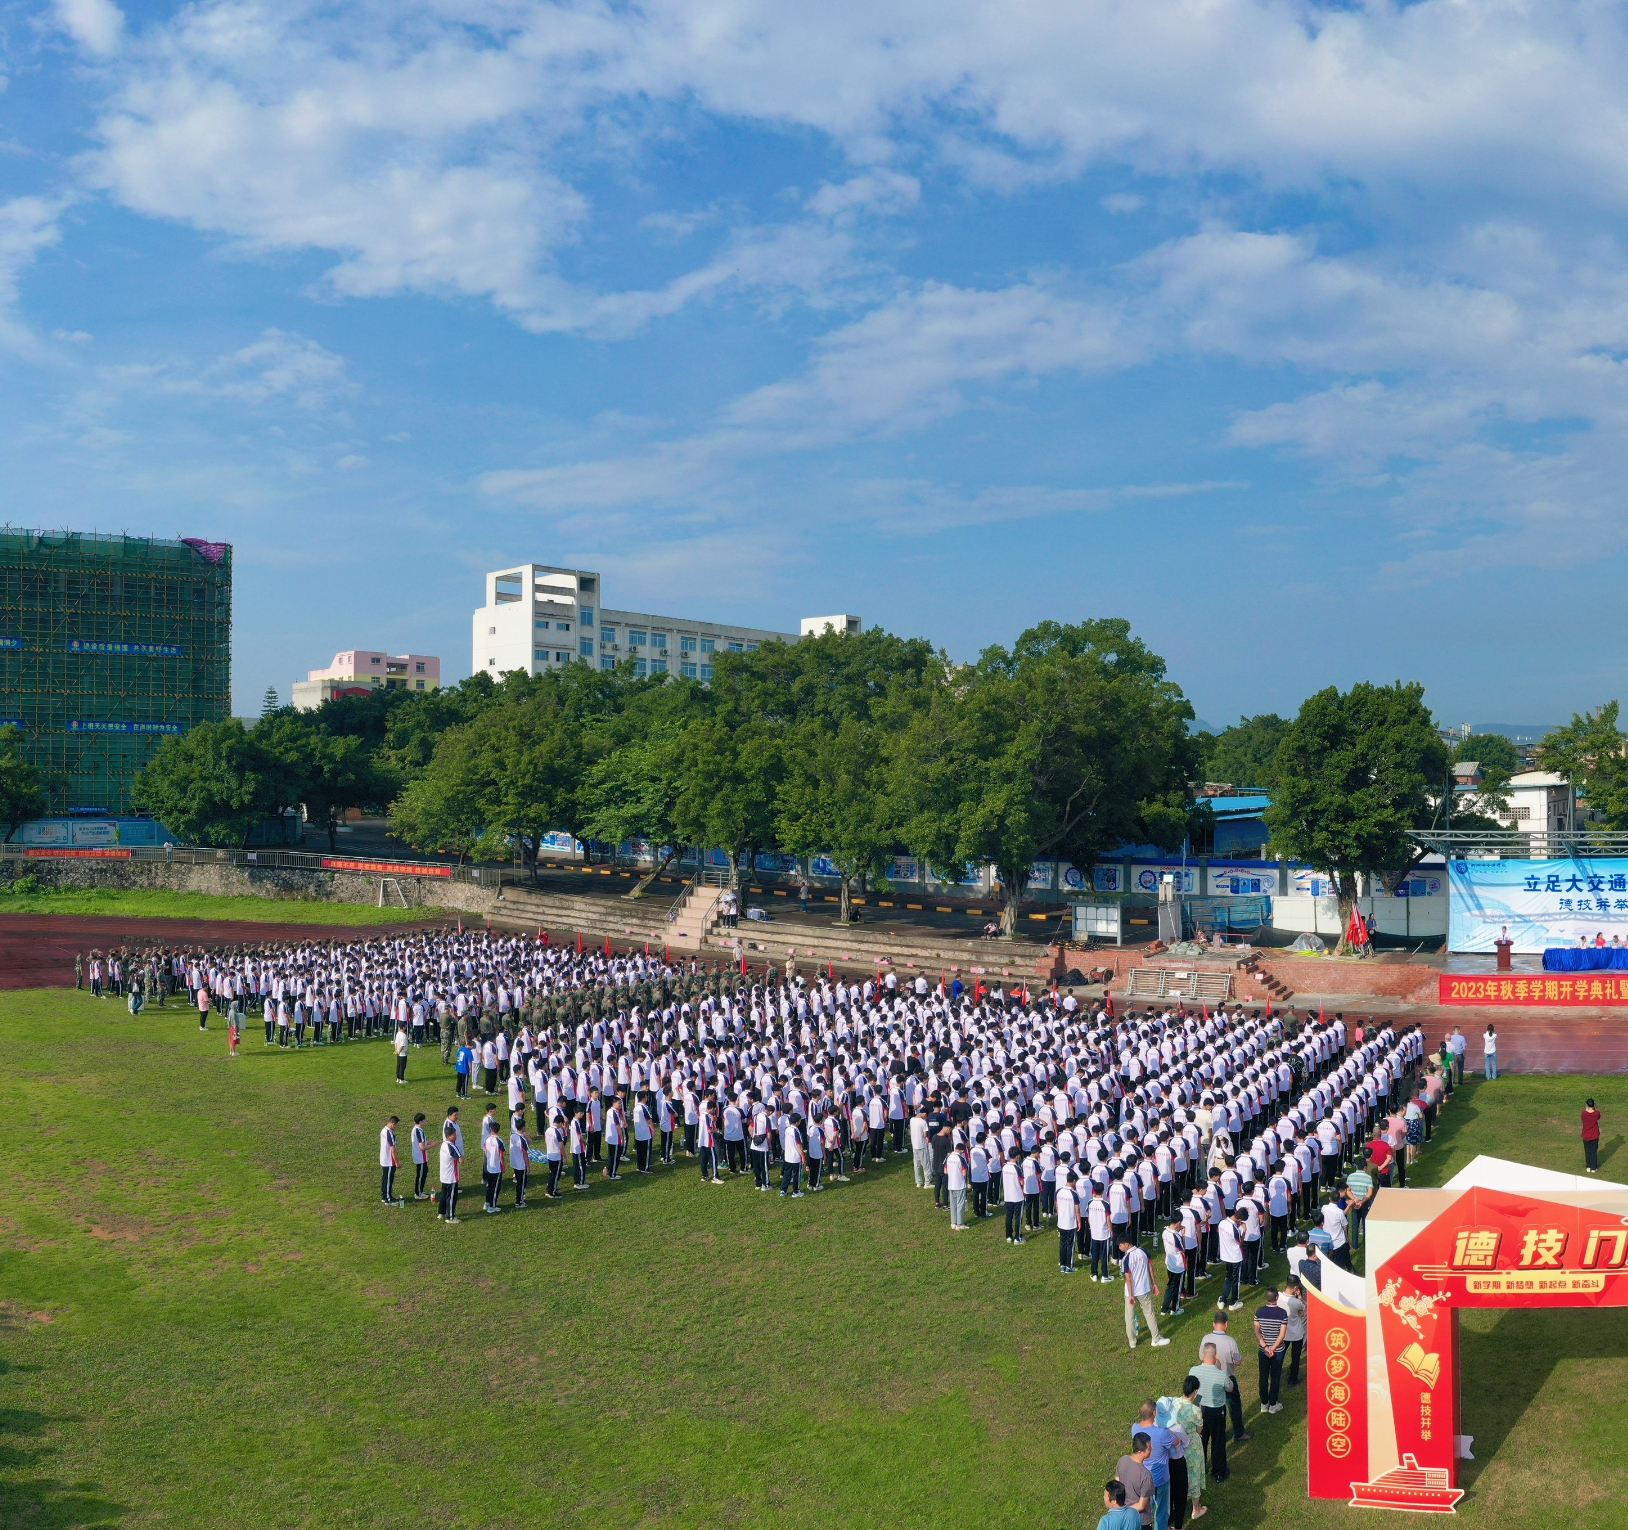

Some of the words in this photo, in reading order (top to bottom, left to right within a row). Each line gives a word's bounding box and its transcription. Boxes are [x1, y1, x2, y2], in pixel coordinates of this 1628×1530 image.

[1523, 873, 1628, 893] 立足大交通
[1452, 1229, 1628, 1267] 德技门
[1473, 1281, 1501, 1290] 新学期
[1506, 1281, 1534, 1290] 新梦想
[1539, 1281, 1567, 1289] 新起点
[1572, 1280, 1600, 1289] 新奋斗
[1328, 1330, 1349, 1457] 筑梦海陆空
[1420, 1392, 1432, 1441] 德技并举
